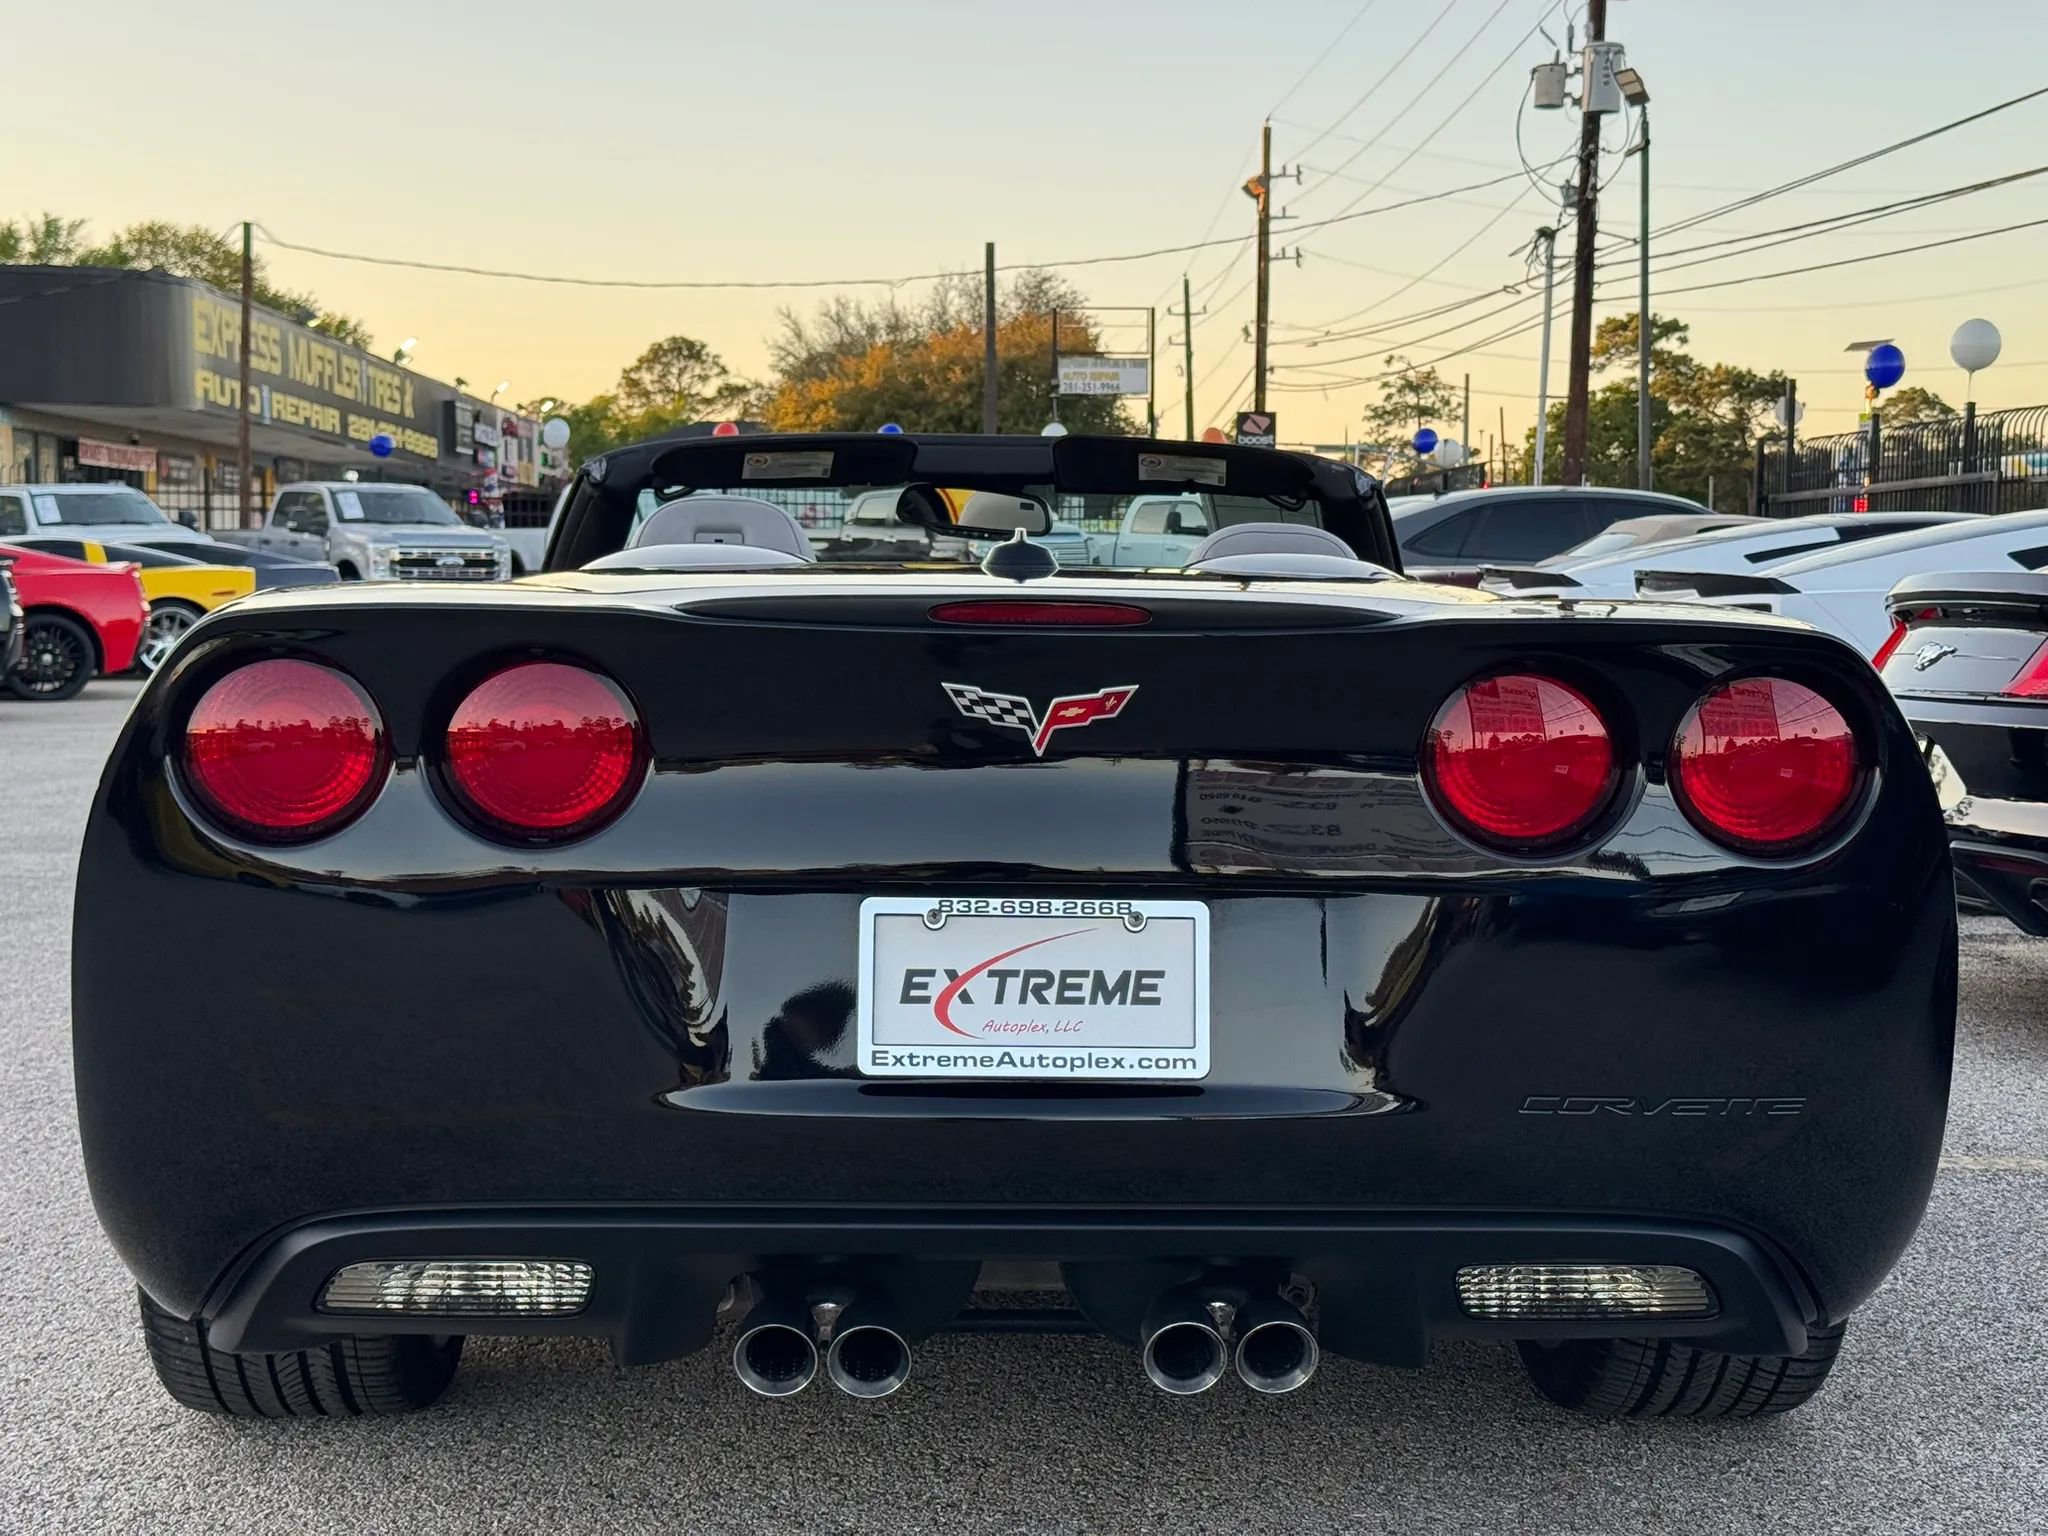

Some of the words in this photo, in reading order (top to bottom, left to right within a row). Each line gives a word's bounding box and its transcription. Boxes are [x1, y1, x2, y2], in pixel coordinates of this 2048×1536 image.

[288, 331, 362, 402] MUFFLER
[272, 392, 340, 434] REPAIR
[1237, 434, 1274, 445] boost
[938, 899, 1133, 915] 832-698-2668
[899, 967, 1166, 1006] EXTREME
[982, 1019, 1050, 1036] Autoplex,
[1054, 1020, 1084, 1033] LLC
[871, 1050, 1197, 1073] ExtremeAutoplex.com
[1517, 1096, 1808, 1116] CORVETTE
